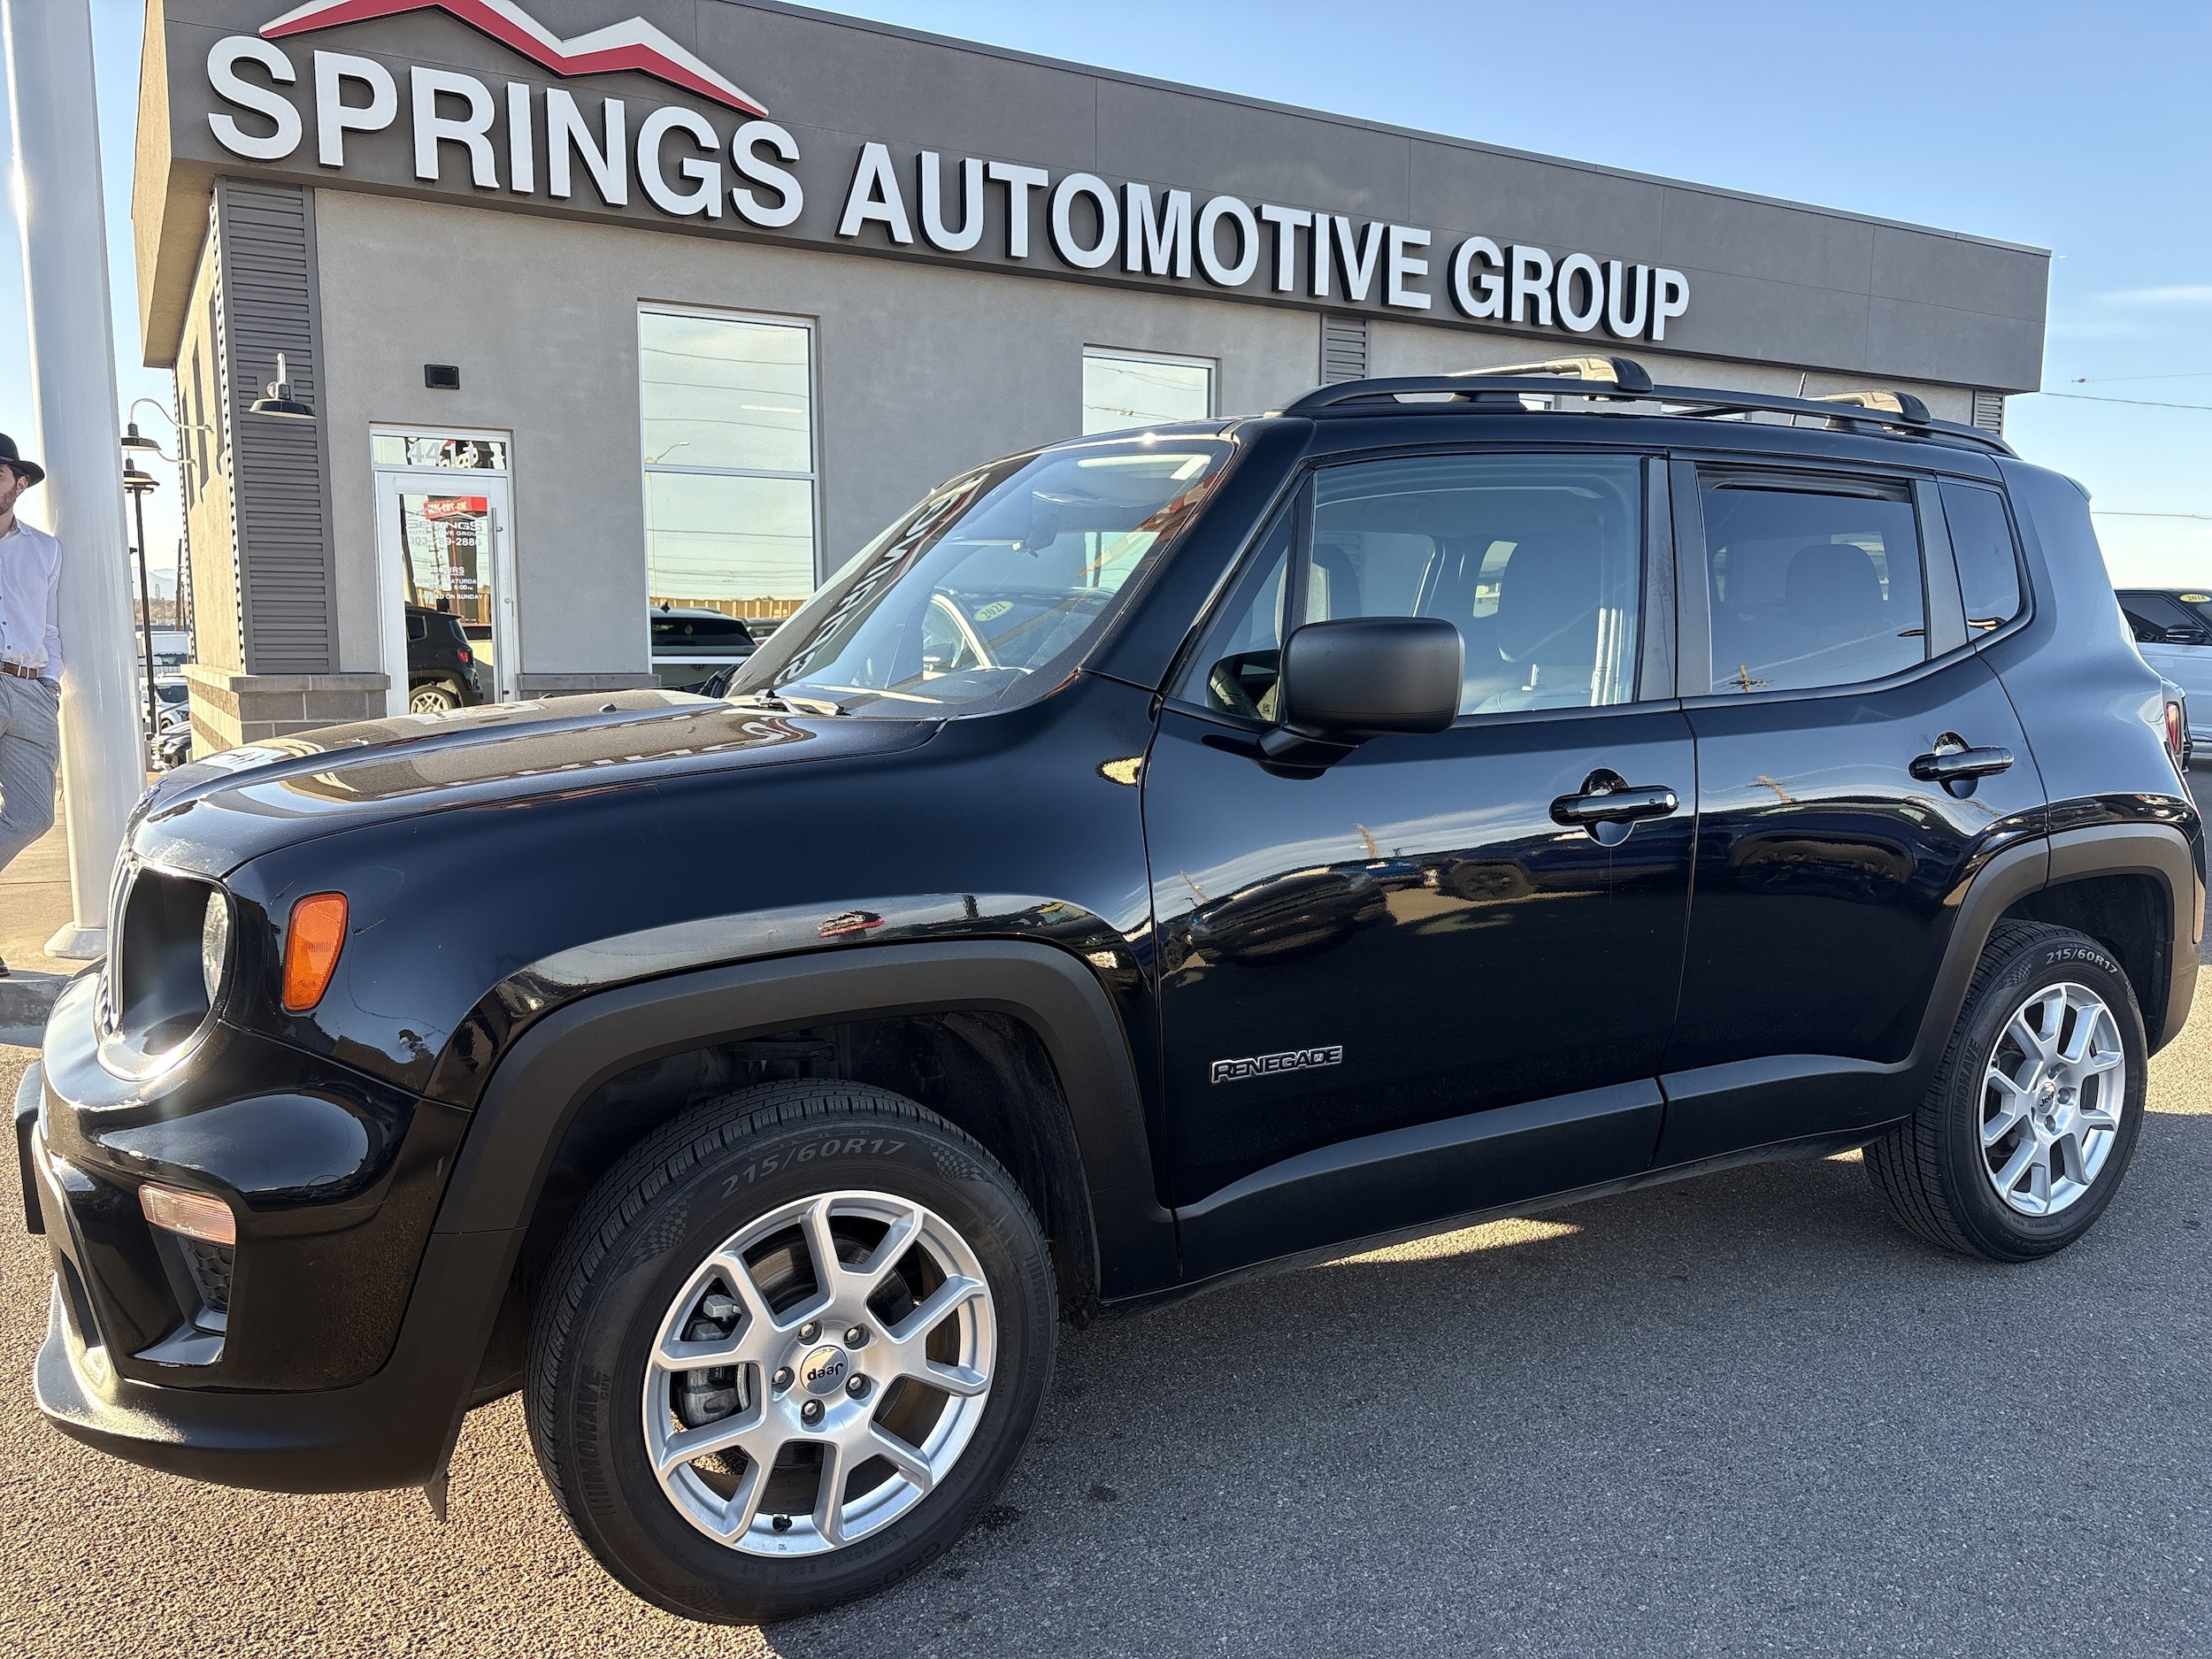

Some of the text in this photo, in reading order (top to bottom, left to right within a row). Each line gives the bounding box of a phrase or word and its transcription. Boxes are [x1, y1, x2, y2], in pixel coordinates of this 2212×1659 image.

[205, 35, 1691, 342] SPRINGS AUTOMOTIVE GROUP
[980, 603, 1007, 618] 2021
[2046, 948, 2118, 974] 215/60R17
[1210, 1046, 1343, 1084] RENEGADE
[720, 1138, 906, 1201] 215/60R17
[807, 1362, 844, 1381] Jeep
[576, 1364, 605, 1483] MOHAVE
